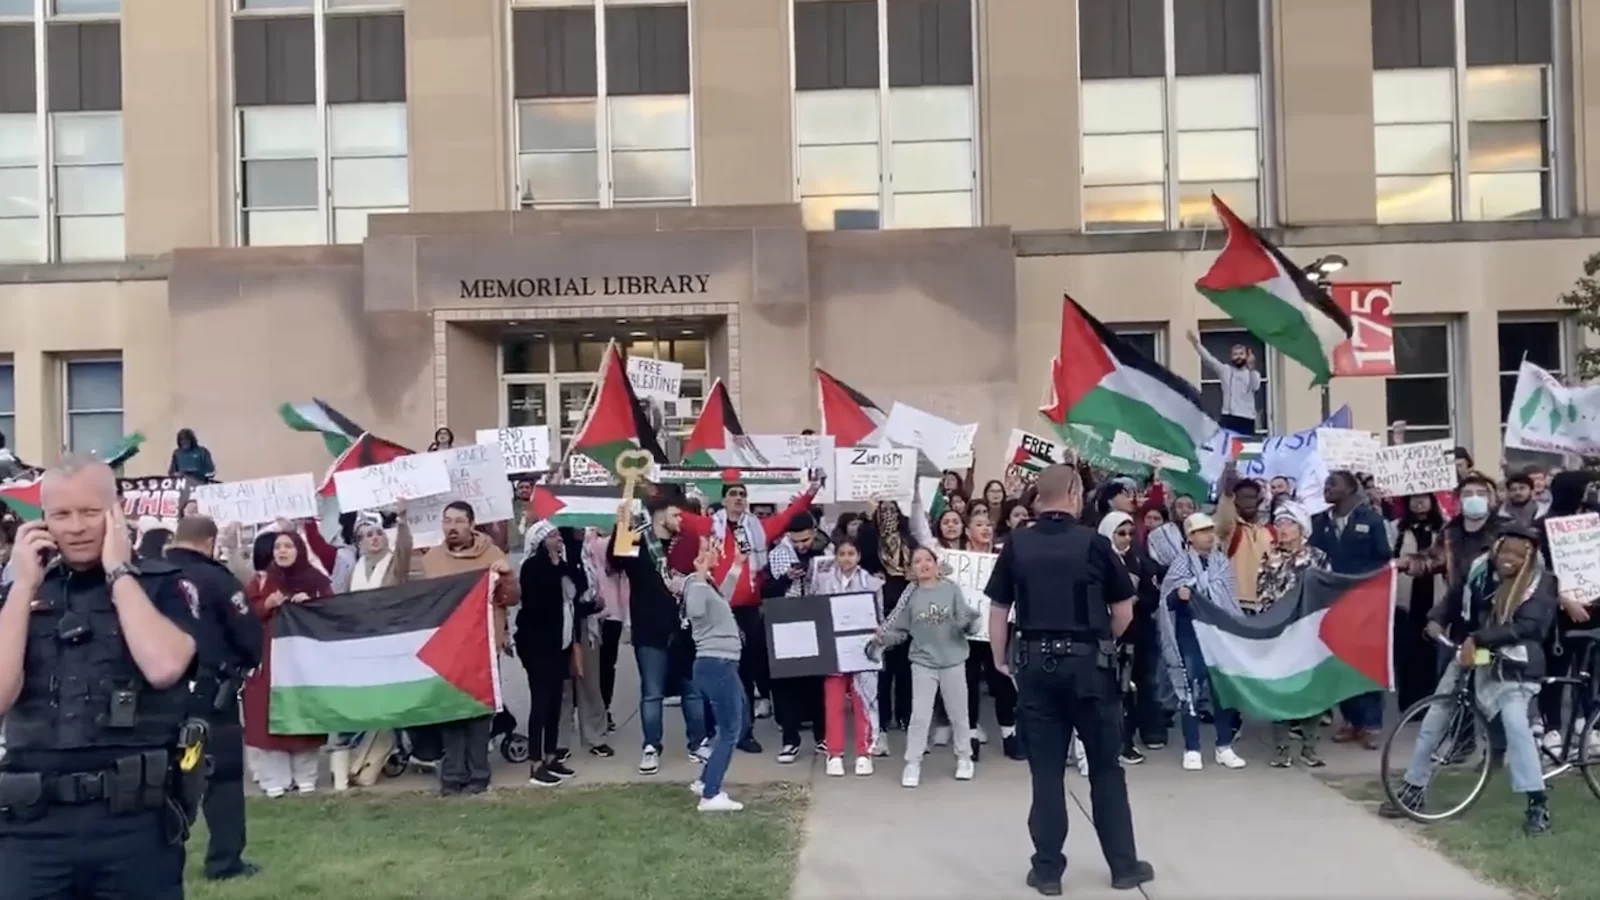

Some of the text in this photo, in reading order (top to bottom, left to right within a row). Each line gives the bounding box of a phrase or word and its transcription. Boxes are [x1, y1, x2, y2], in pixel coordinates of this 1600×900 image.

[460, 275, 710, 298] MEMORIAL LIBRARY
[1351, 289, 1394, 368] 175
[638, 360, 662, 376] FREE
[629, 373, 678, 395] ALESTINE
[498, 427, 523, 441] END
[1021, 434, 1055, 457] FREE
[121, 478, 187, 491] DISON
[123, 490, 181, 515] THE
